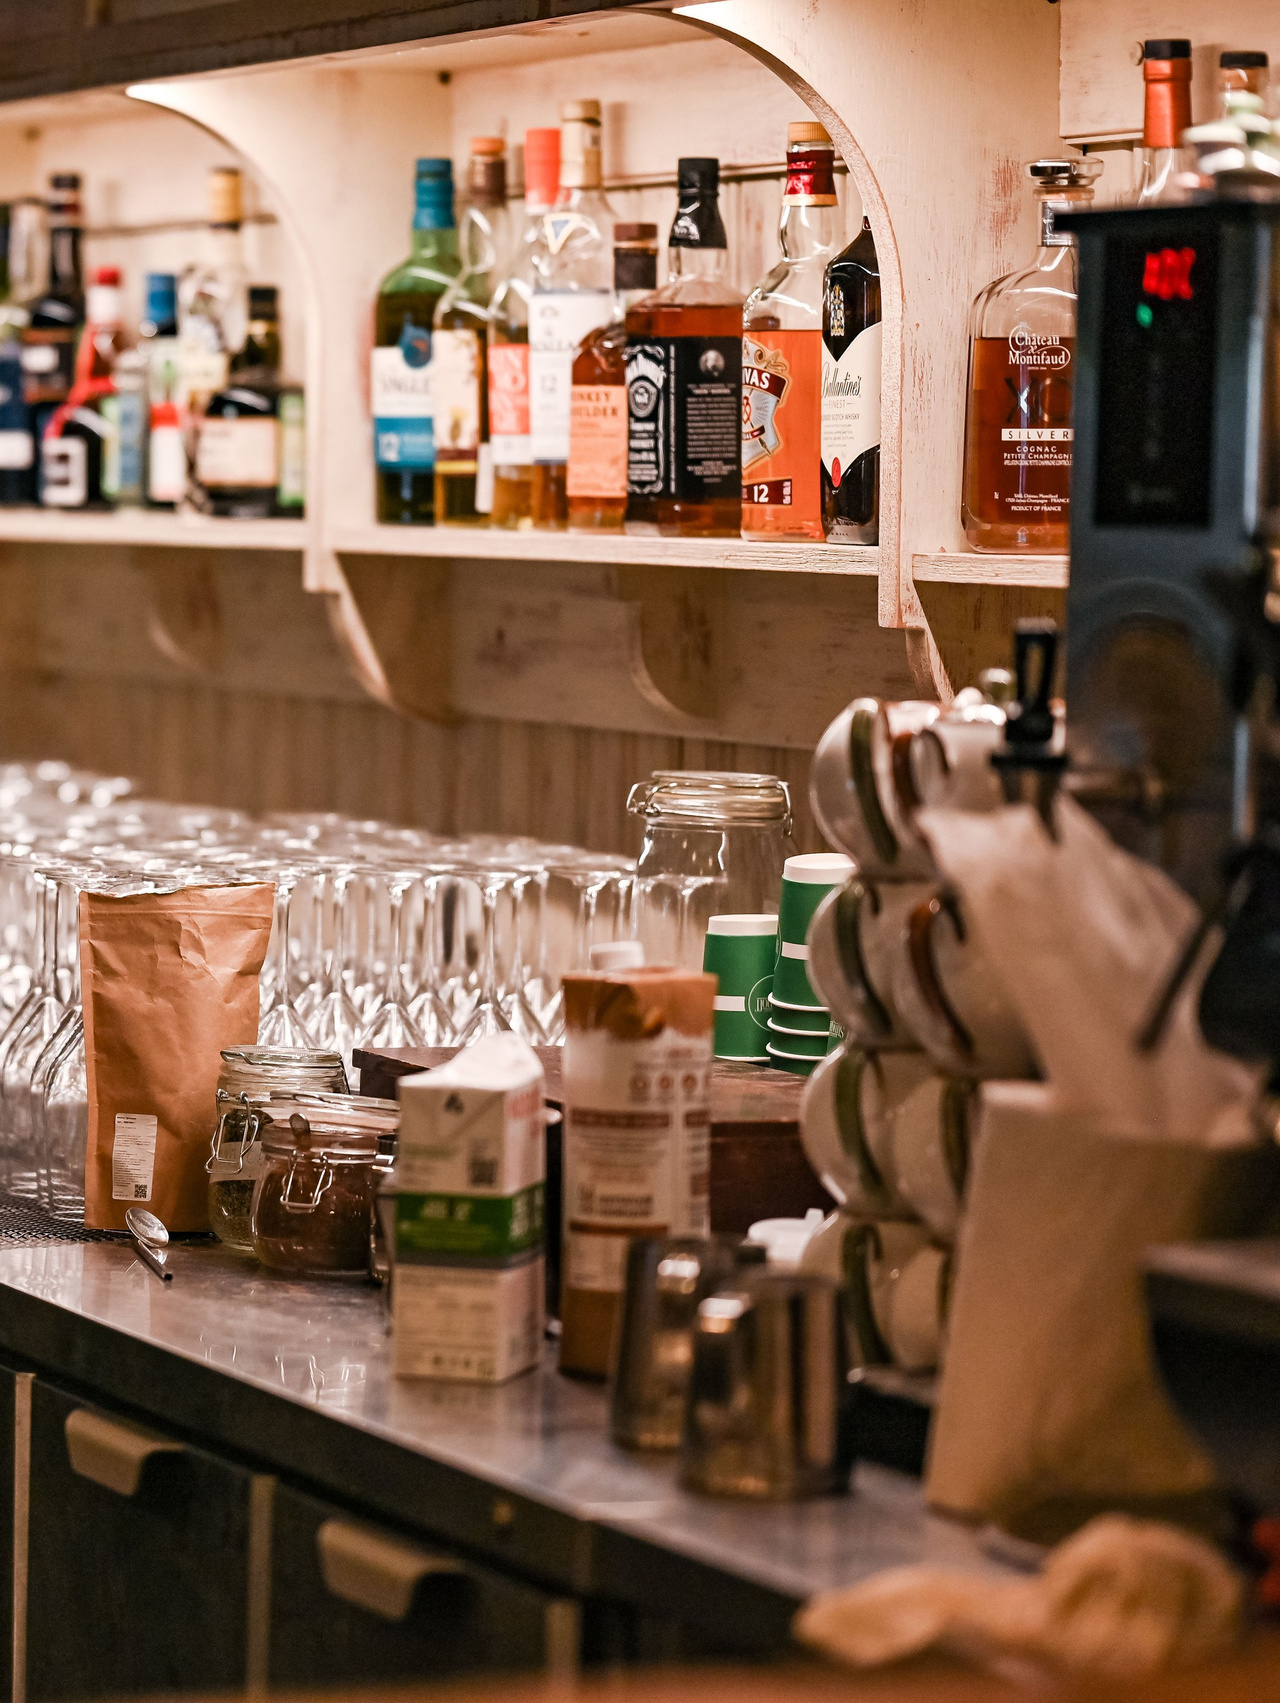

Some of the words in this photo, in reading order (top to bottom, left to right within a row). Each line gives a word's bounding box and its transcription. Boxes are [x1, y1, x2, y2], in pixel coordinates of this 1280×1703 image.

[1015, 330, 1060, 346] Château
[1008, 350, 1066, 365] Montifaud
[821, 361, 862, 398] Ballantine's
[828, 400, 846, 409] FINEST
[1008, 430, 1069, 440] SILVER
[753, 483, 770, 503] 12
